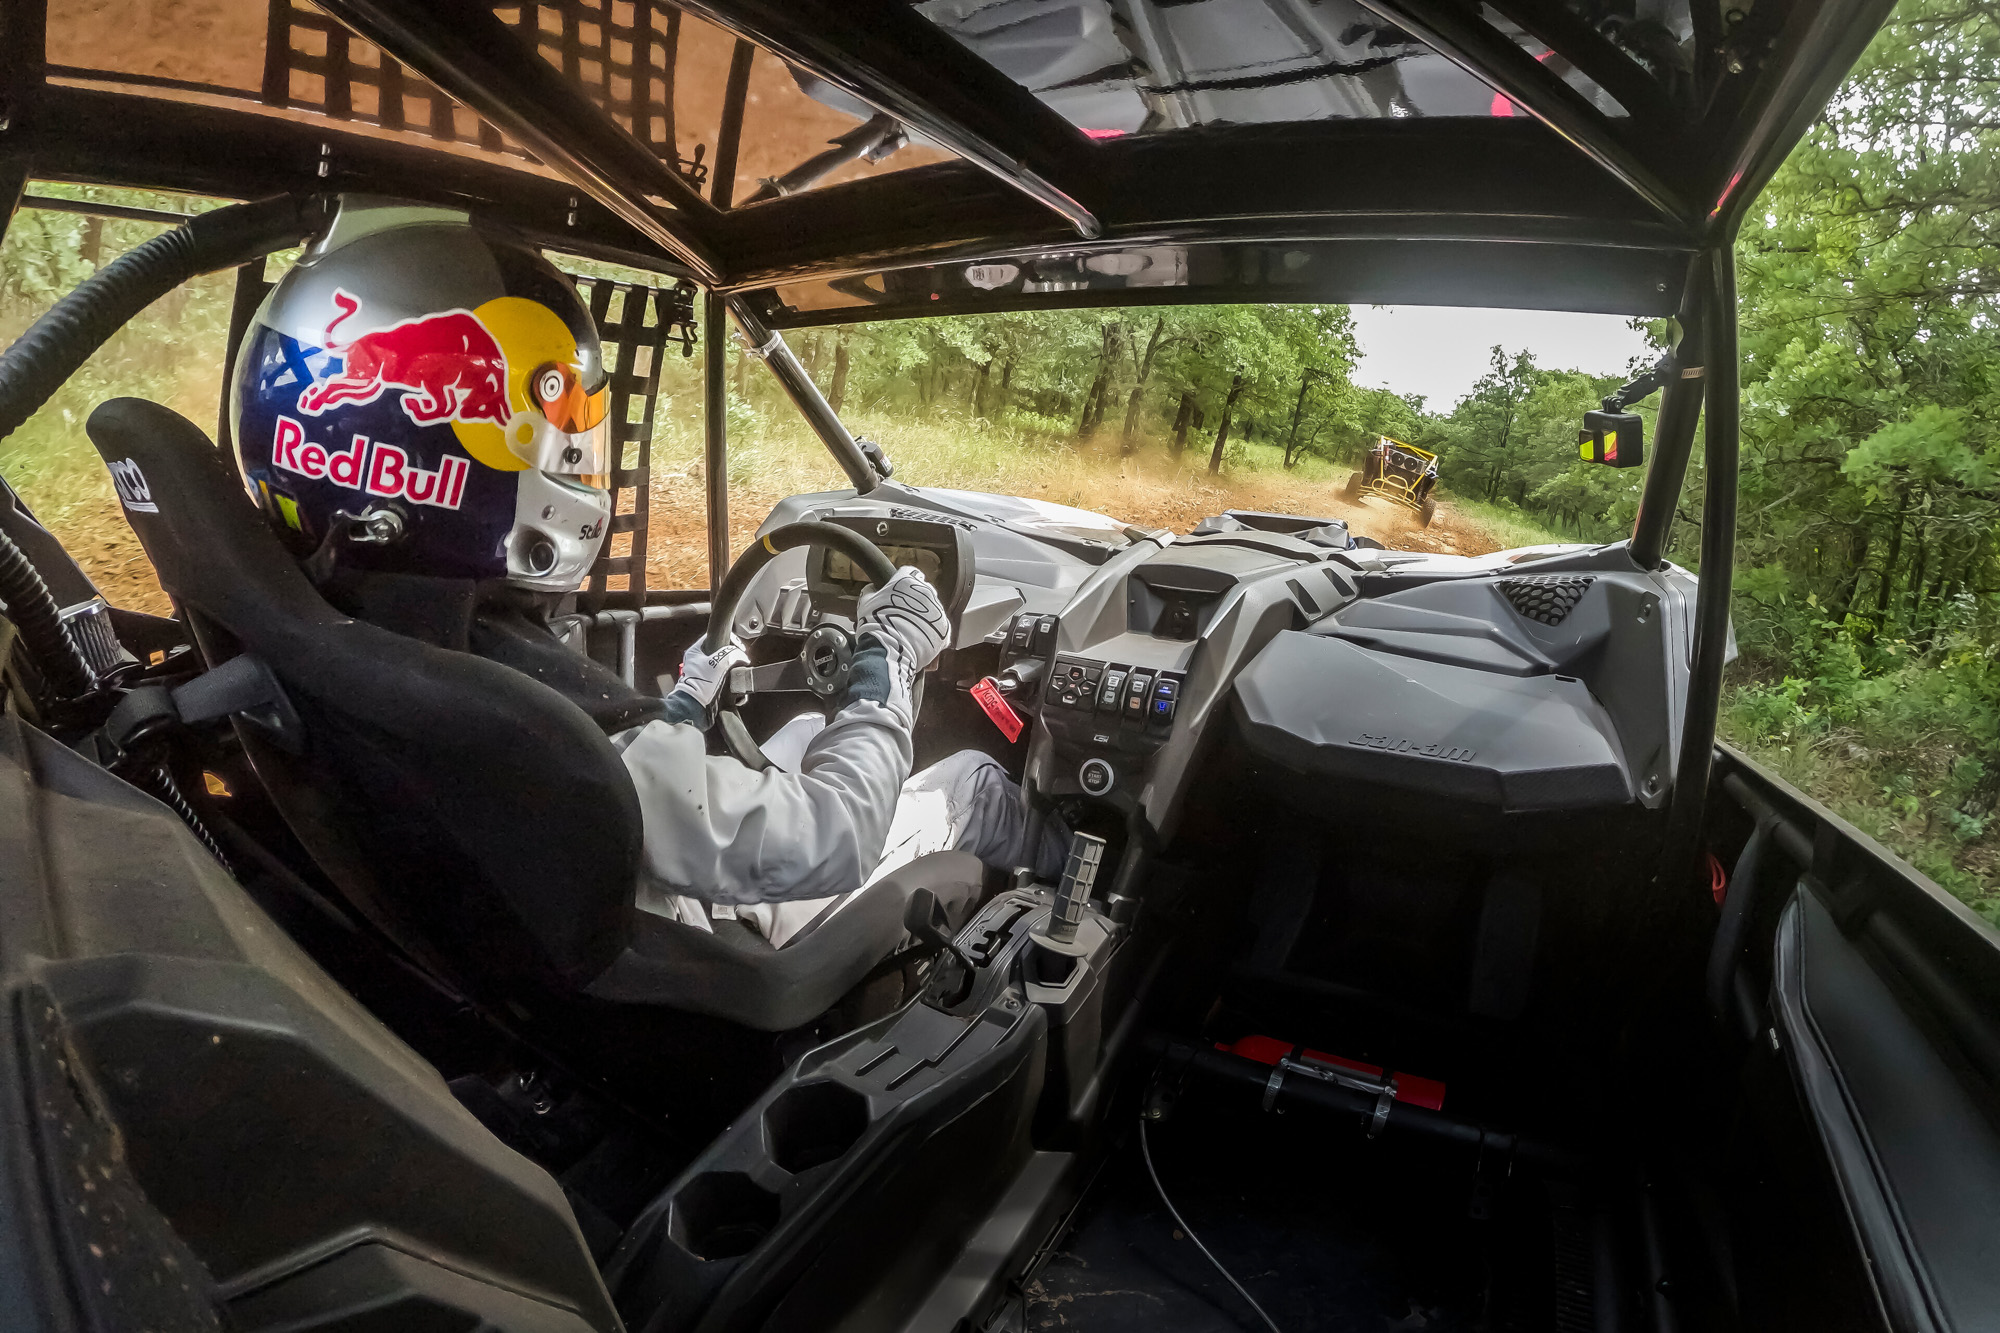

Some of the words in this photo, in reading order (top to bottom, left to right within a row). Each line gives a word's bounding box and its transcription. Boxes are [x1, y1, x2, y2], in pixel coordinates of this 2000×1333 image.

[273, 416, 369, 489] Red
[366, 442, 470, 510] Bull
[1348, 733, 1477, 763] can-am
